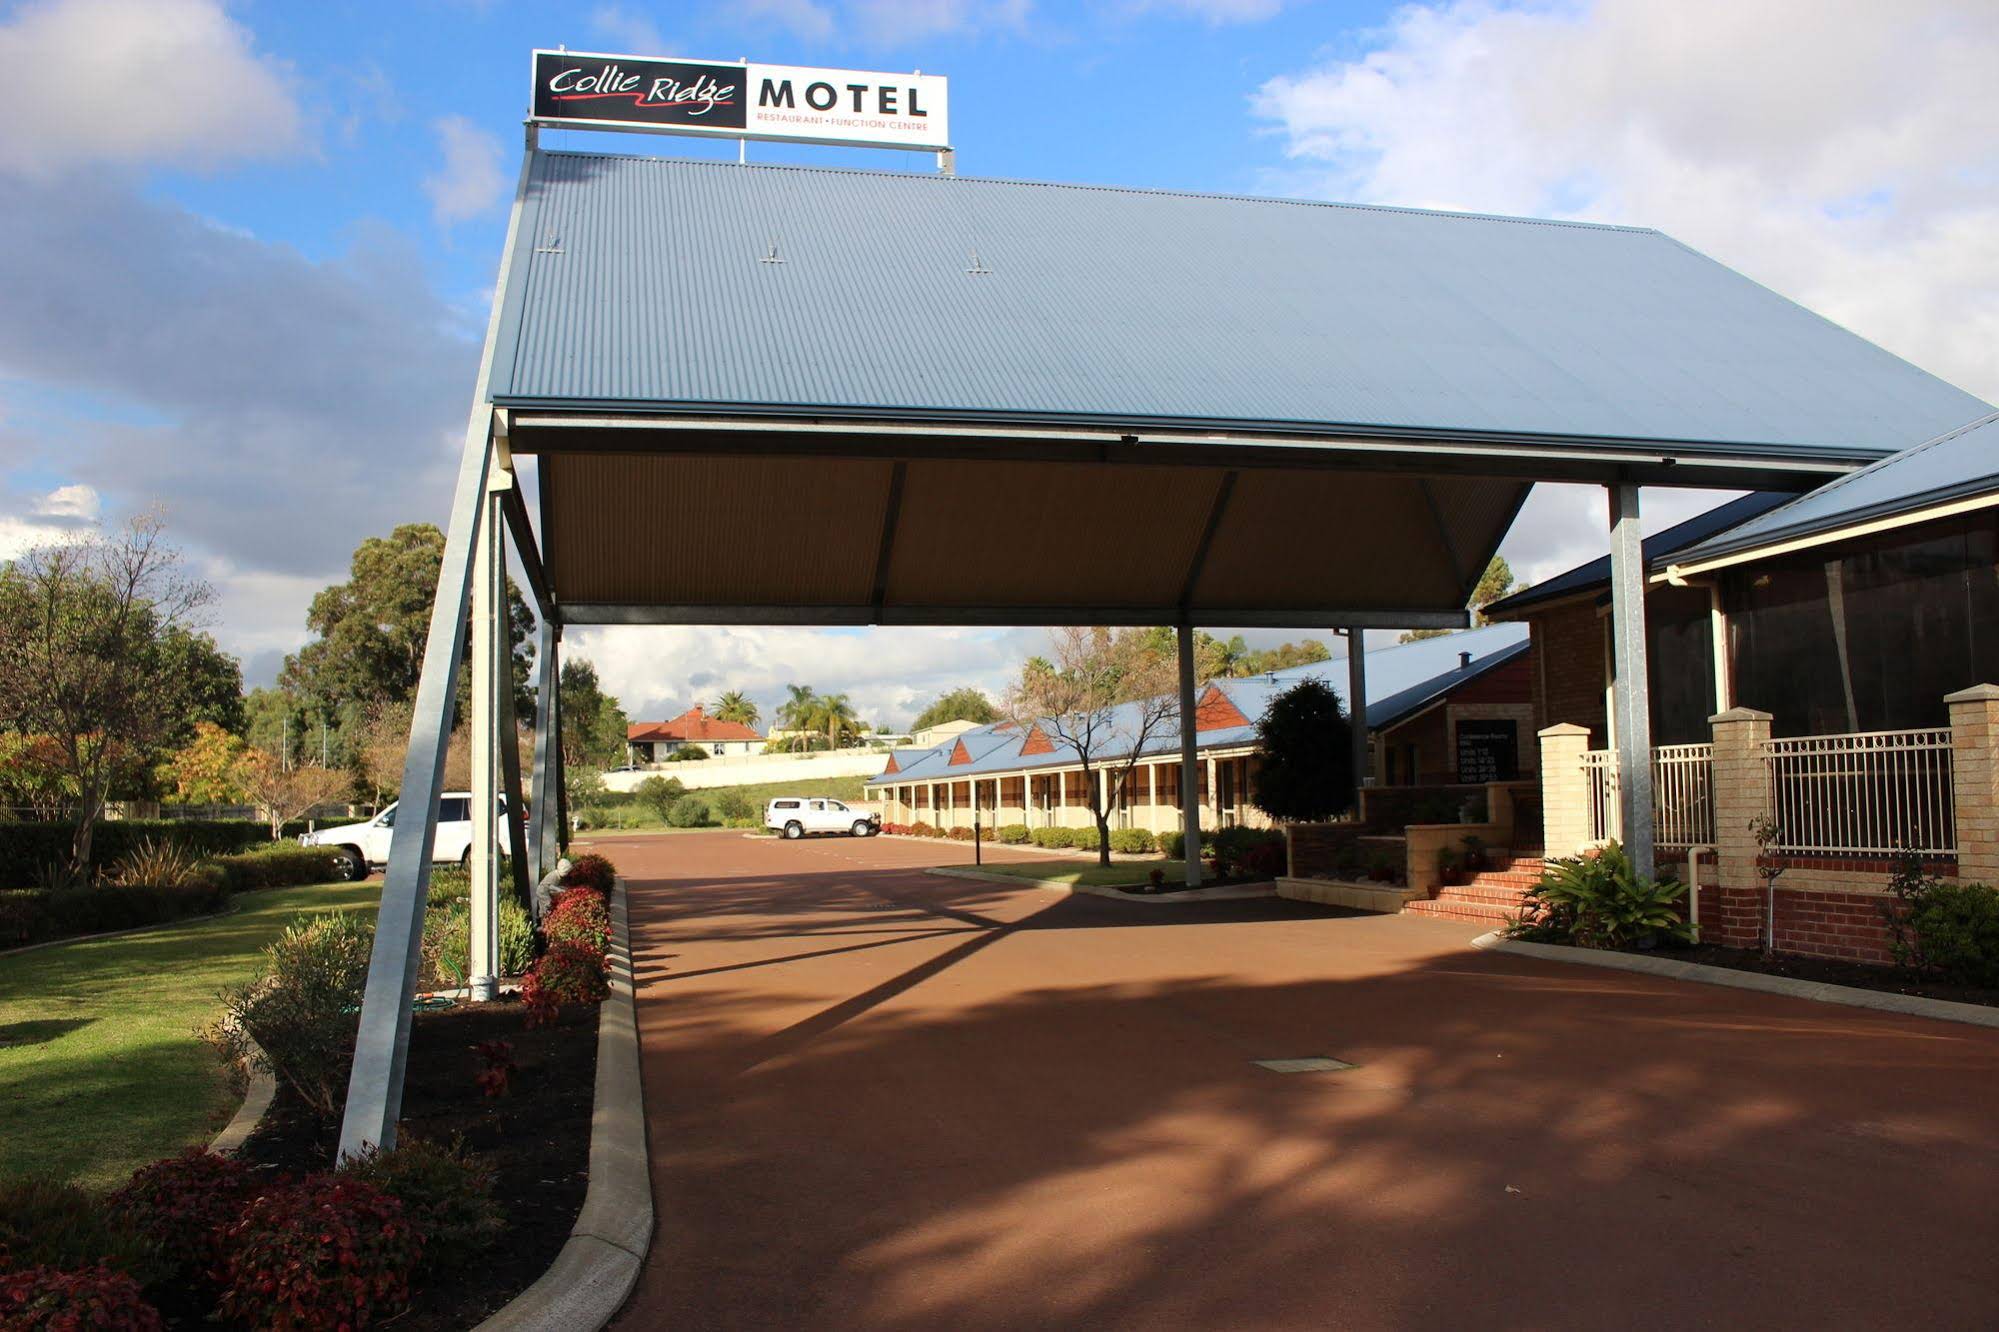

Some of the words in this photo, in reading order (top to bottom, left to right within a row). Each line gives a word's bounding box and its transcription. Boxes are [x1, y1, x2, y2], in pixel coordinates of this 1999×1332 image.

[550, 65, 641, 94] Collie
[647, 75, 736, 115] Ridge
[758, 78, 928, 117] MOTEL
[757, 113, 823, 124] RESTAURANT
[831, 117, 886, 128] FUNCTION
[889, 122, 928, 132] CENTRE
